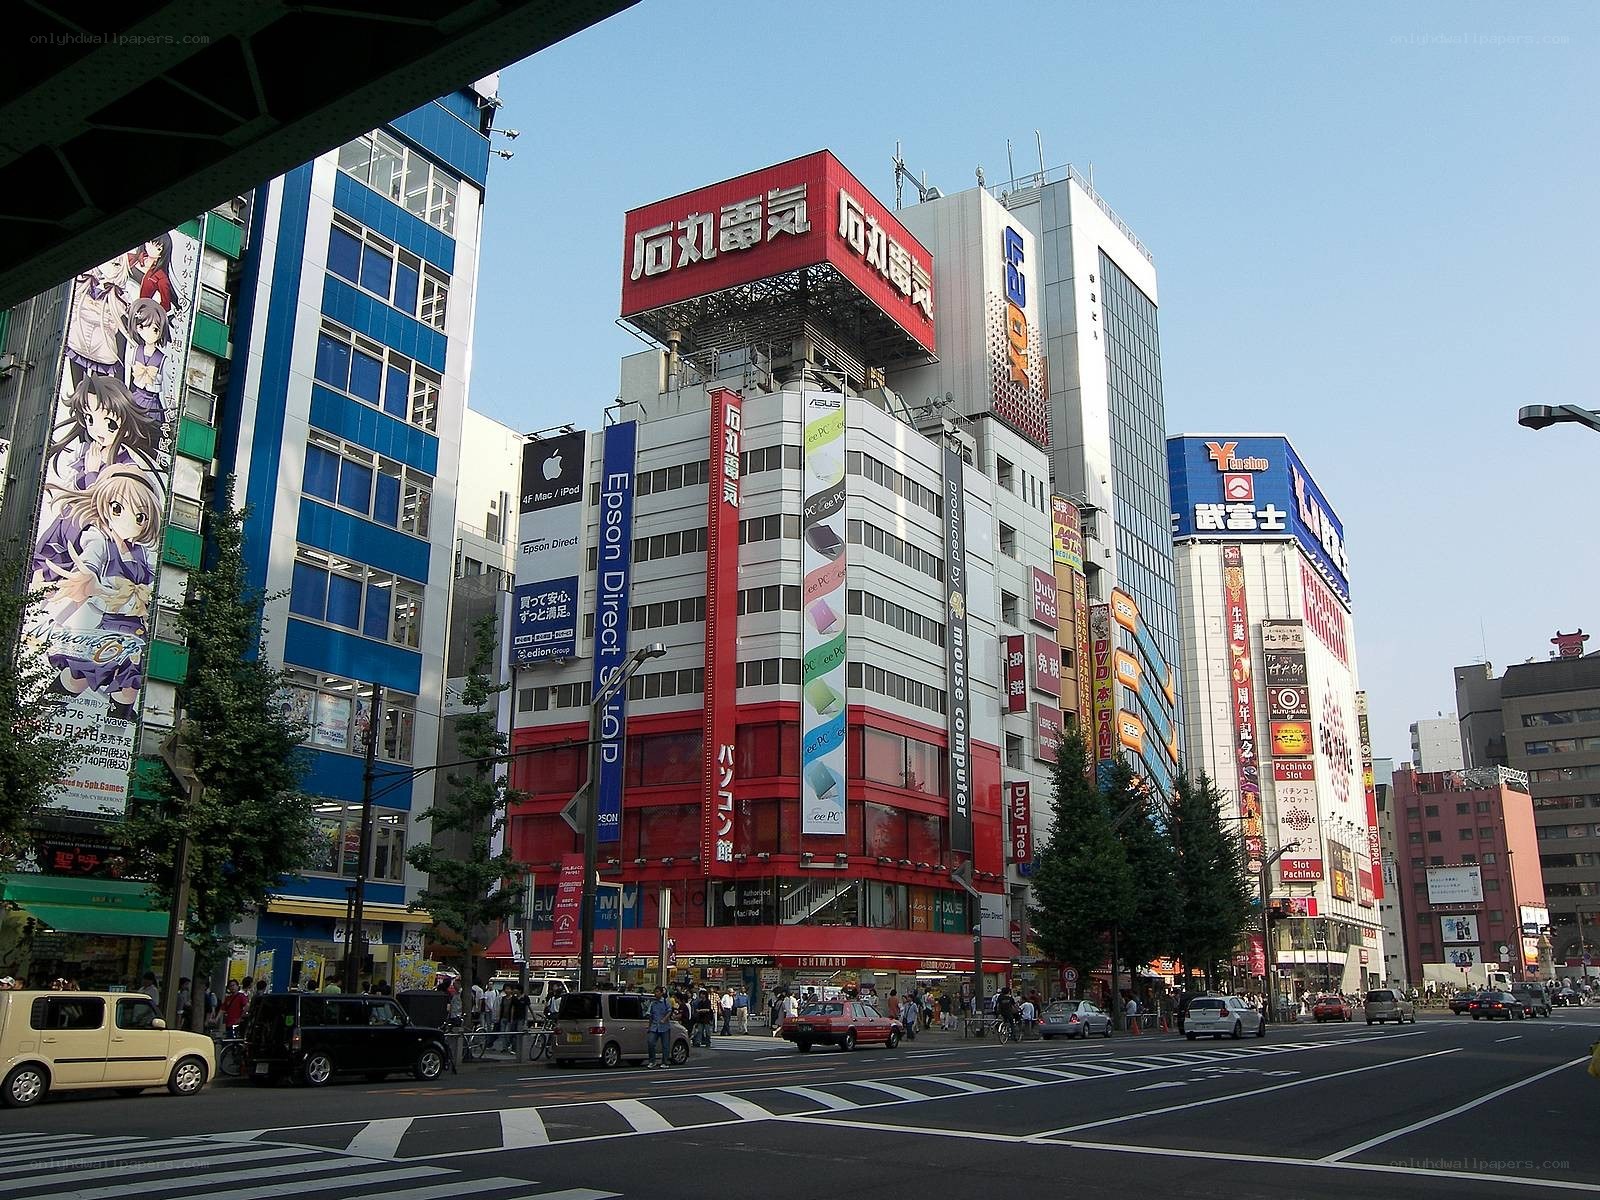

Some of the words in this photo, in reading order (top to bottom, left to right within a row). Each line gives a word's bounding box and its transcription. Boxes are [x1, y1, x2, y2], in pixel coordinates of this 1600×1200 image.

[630, 182, 811, 281] 石丸電気
[838, 186, 934, 321] 石丸電気
[809, 398, 841, 408] ASUS
[723, 403, 740, 508] 石丸電気
[1243, 456, 1269, 471] shop
[522, 494, 534, 504] 4F
[534, 492, 553, 502] Mac
[560, 484, 580, 497] iPod
[602, 472, 629, 560] Epson
[804, 505, 817, 519] PC
[948, 479, 961, 562] produced
[1194, 502, 1287, 530] 武富士
[523, 541, 550, 555] Epson
[551, 535, 579, 548] Direct
[817, 574, 830, 587] PC
[950, 566, 961, 588] by
[1034, 576, 1056, 604] Duty
[519, 604, 571, 624] ずっと満足。
[600, 571, 625, 656] Direct
[1035, 598, 1057, 618] Free
[1264, 633, 1304, 643] 北海道
[526, 646, 551, 658] edion
[551, 646, 570, 656] Group
[952, 625, 966, 701] mouse
[1037, 652, 1060, 680] 免税
[1009, 651, 1025, 697] 免税
[816, 733, 830, 747] PC
[952, 706, 968, 819] computer
[1275, 762, 1312, 771] Pachinko
[1286, 770, 1303, 779] Slot
[716, 743, 736, 862] パソコン館
[1013, 786, 1026, 823] Duty
[826, 811, 840, 822] PC
[1015, 825, 1028, 859] Free
[1283, 870, 1321, 879] Pachinko
[1292, 861, 1310, 869] Slot
[935, 900, 963, 914] PIXUS
[797, 956, 848, 967] ISHIMARU
